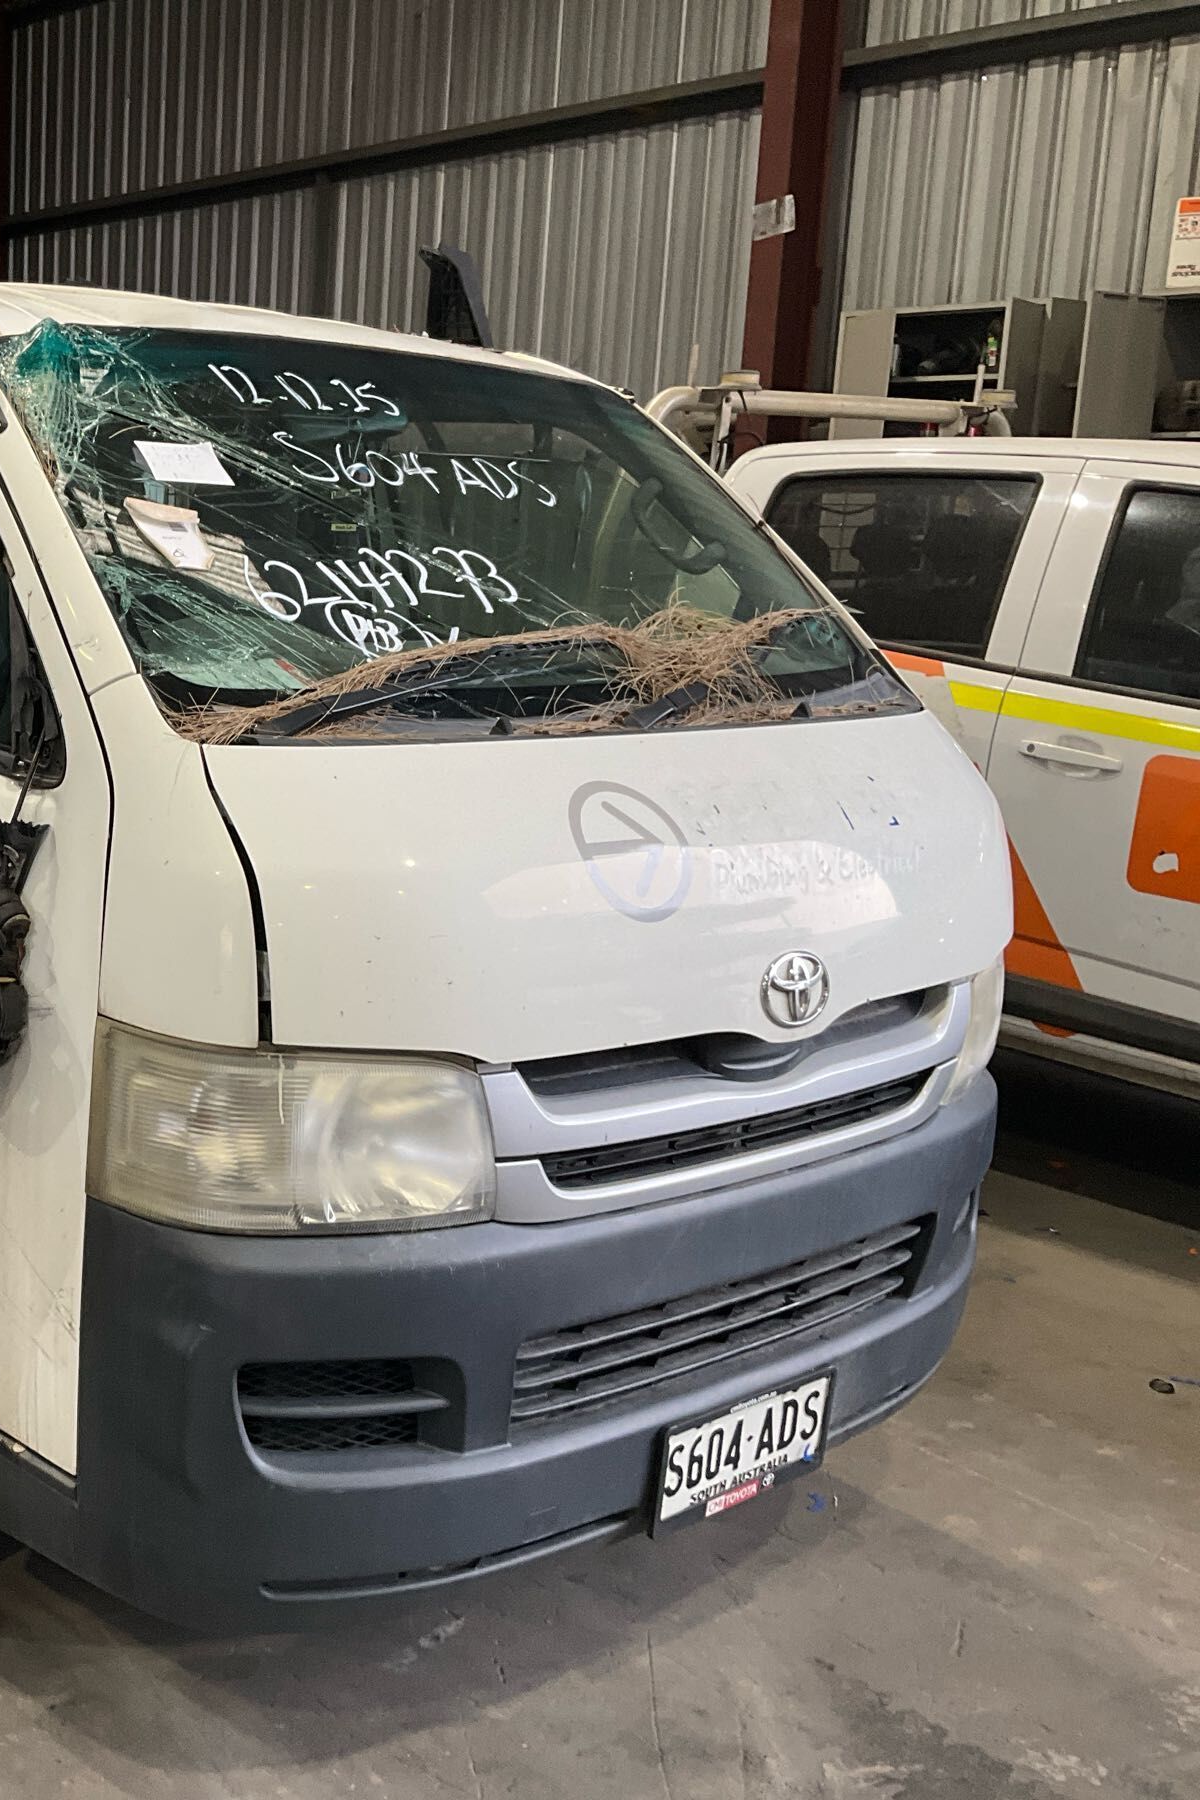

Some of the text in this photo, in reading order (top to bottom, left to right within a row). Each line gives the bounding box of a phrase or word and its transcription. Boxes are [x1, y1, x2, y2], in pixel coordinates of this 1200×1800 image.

[272, 431, 440, 494] S604
[450, 457, 557, 507] ADS
[689, 1453, 787, 1504] SOUTH AUSTRALIA
[725, 1483, 758, 1507] TOYOTA
